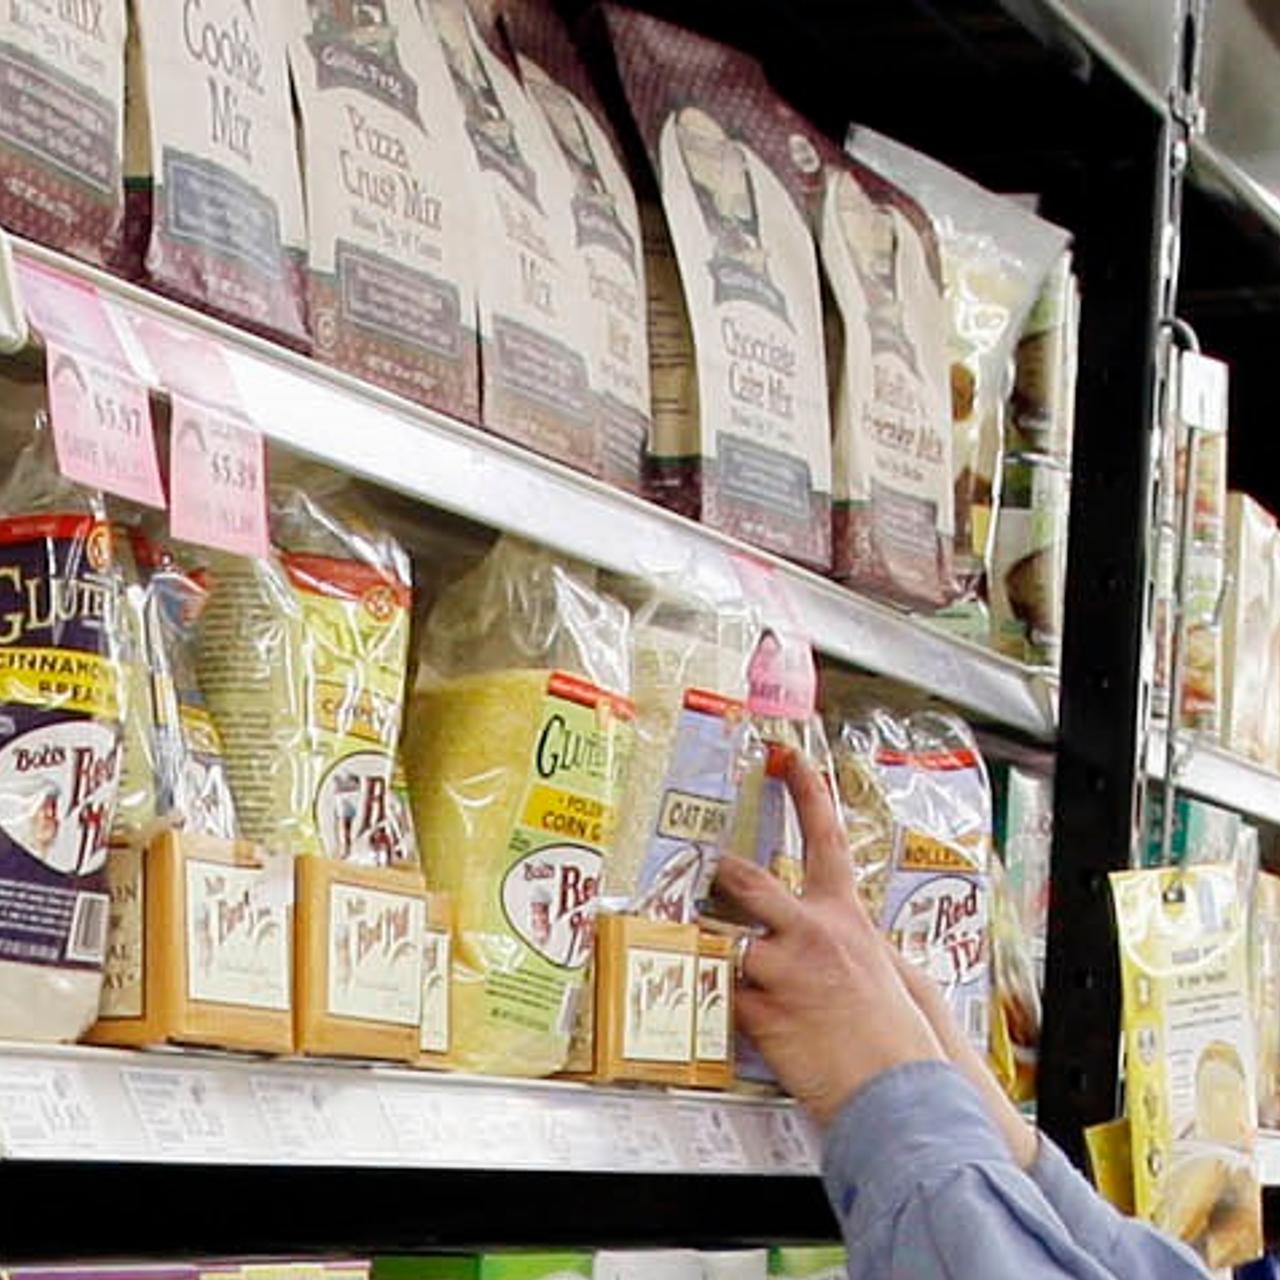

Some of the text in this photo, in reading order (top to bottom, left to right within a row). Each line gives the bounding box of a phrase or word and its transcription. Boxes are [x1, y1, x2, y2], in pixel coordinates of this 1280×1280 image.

[206, 75, 255, 165] Mix
[345, 104, 410, 169] Pizza
[339, 148, 399, 212] Crust
[932, 886, 982, 952] Red
